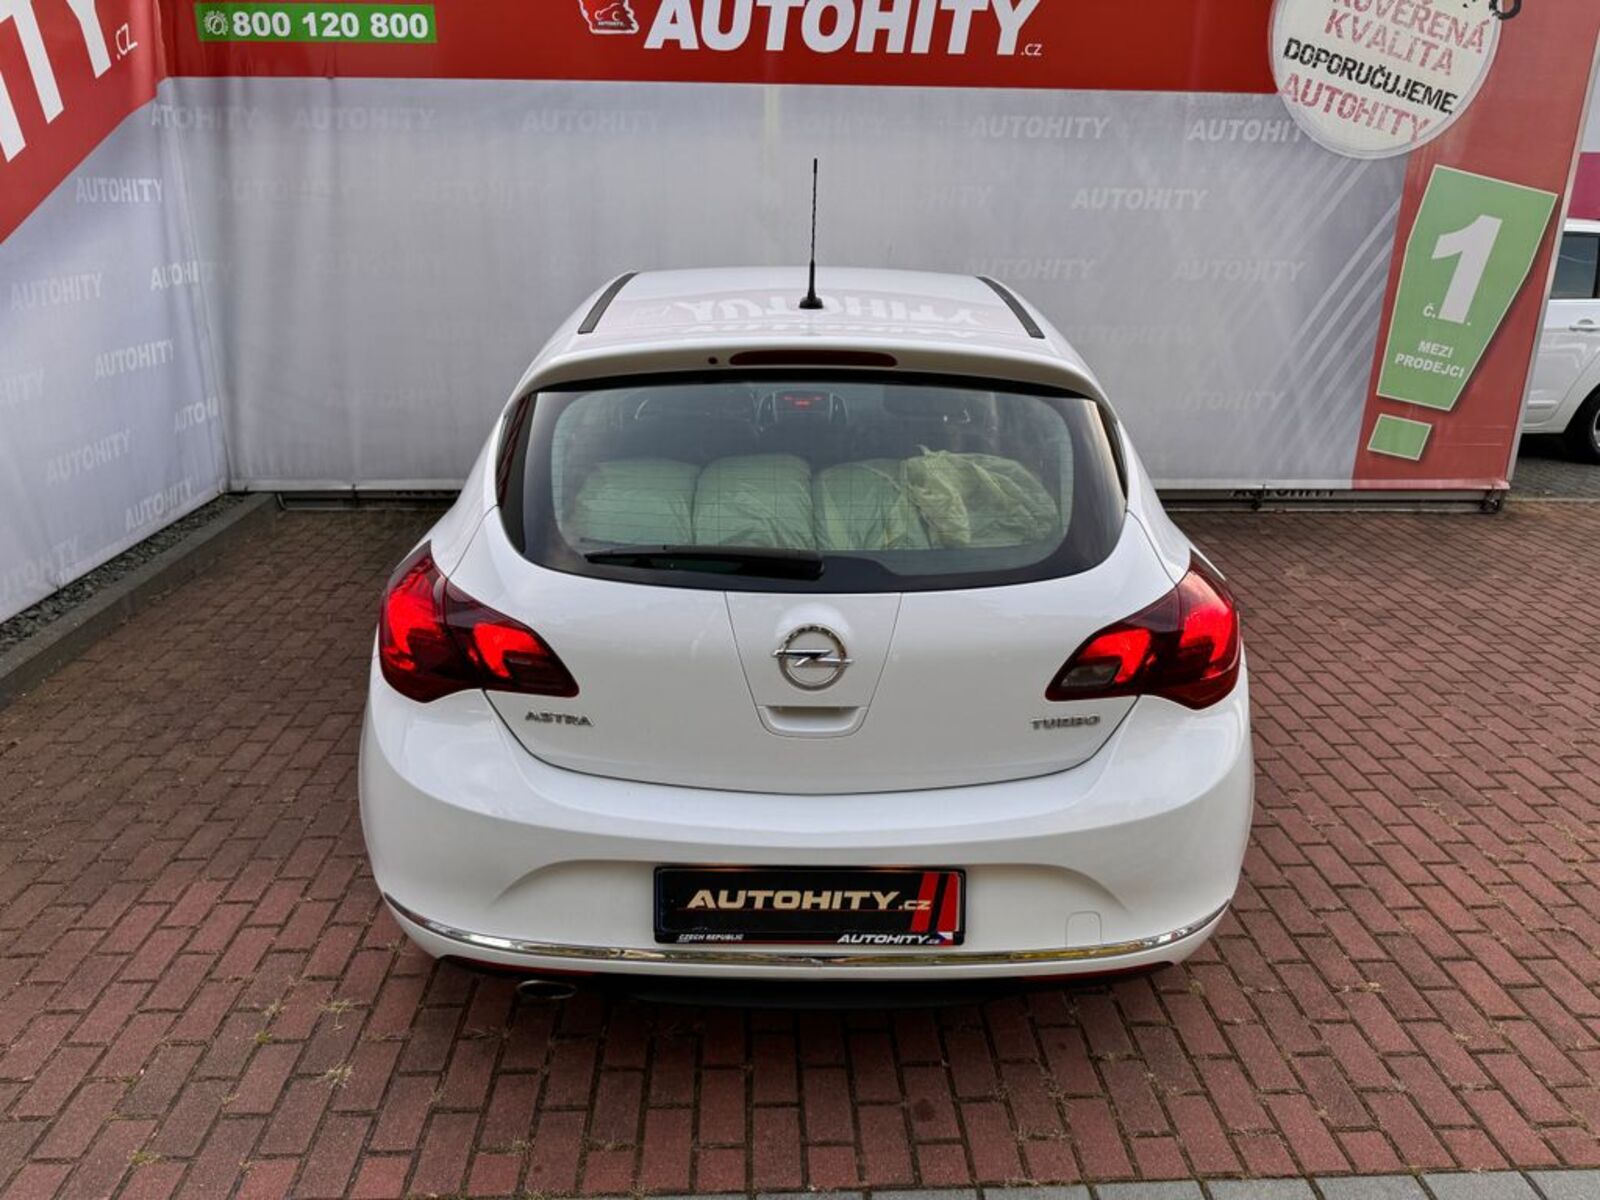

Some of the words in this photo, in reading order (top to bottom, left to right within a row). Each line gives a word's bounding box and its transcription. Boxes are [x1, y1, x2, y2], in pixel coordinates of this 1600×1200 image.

[232, 11, 291, 37] 800
[302, 12, 360, 37] 120
[370, 12, 428, 38] 800
[1324, 8, 1452, 76] KVALITA
[1283, 37, 1458, 114] DOPORUČUJEME
[291, 106, 436, 130] AUTOHITY
[1284, 72, 1431, 143] AUTOHITY
[522, 108, 663, 133] AUTOHITY
[970, 114, 1112, 139] AUTOHITY
[75, 177, 163, 203] AUTOHITY
[1070, 187, 1208, 211] AUTOHITY
[1170, 258, 1307, 281] AUTOHITY
[11, 271, 103, 311] AUTOHITY
[1418, 340, 1453, 358] MEZI
[1394, 353, 1465, 378] PRODEJCI
[47, 428, 131, 488] AUTOHITY
[124, 476, 193, 533] AUTOHITY
[525, 712, 593, 727] ASTRA
[1030, 715, 1101, 730] TURBO
[687, 890, 932, 910] AUTOHITY.cz
[678, 933, 705, 942] CZECH
[706, 933, 745, 942] REPUBLIC
